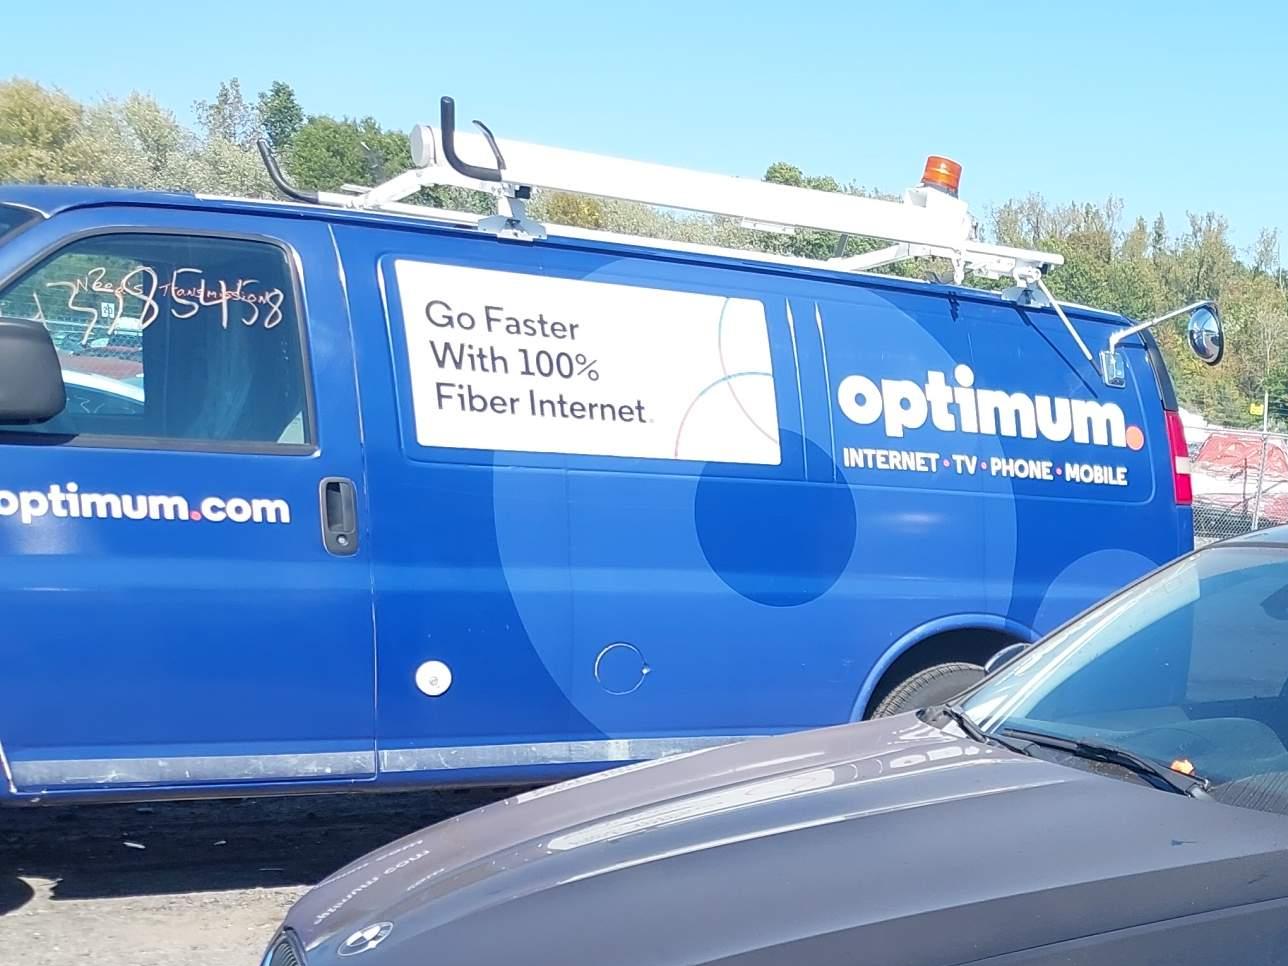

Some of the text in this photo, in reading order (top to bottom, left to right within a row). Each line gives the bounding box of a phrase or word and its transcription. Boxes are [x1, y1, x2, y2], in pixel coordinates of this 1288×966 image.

[425, 300, 580, 340] Go Faster
[429, 340, 600, 382] With 100%
[435, 381, 519, 416] Fiber
[843, 447, 1128, 487] INTERNET TV PHONE MOBILE
[0, 482, 291, 525] optimum.com
